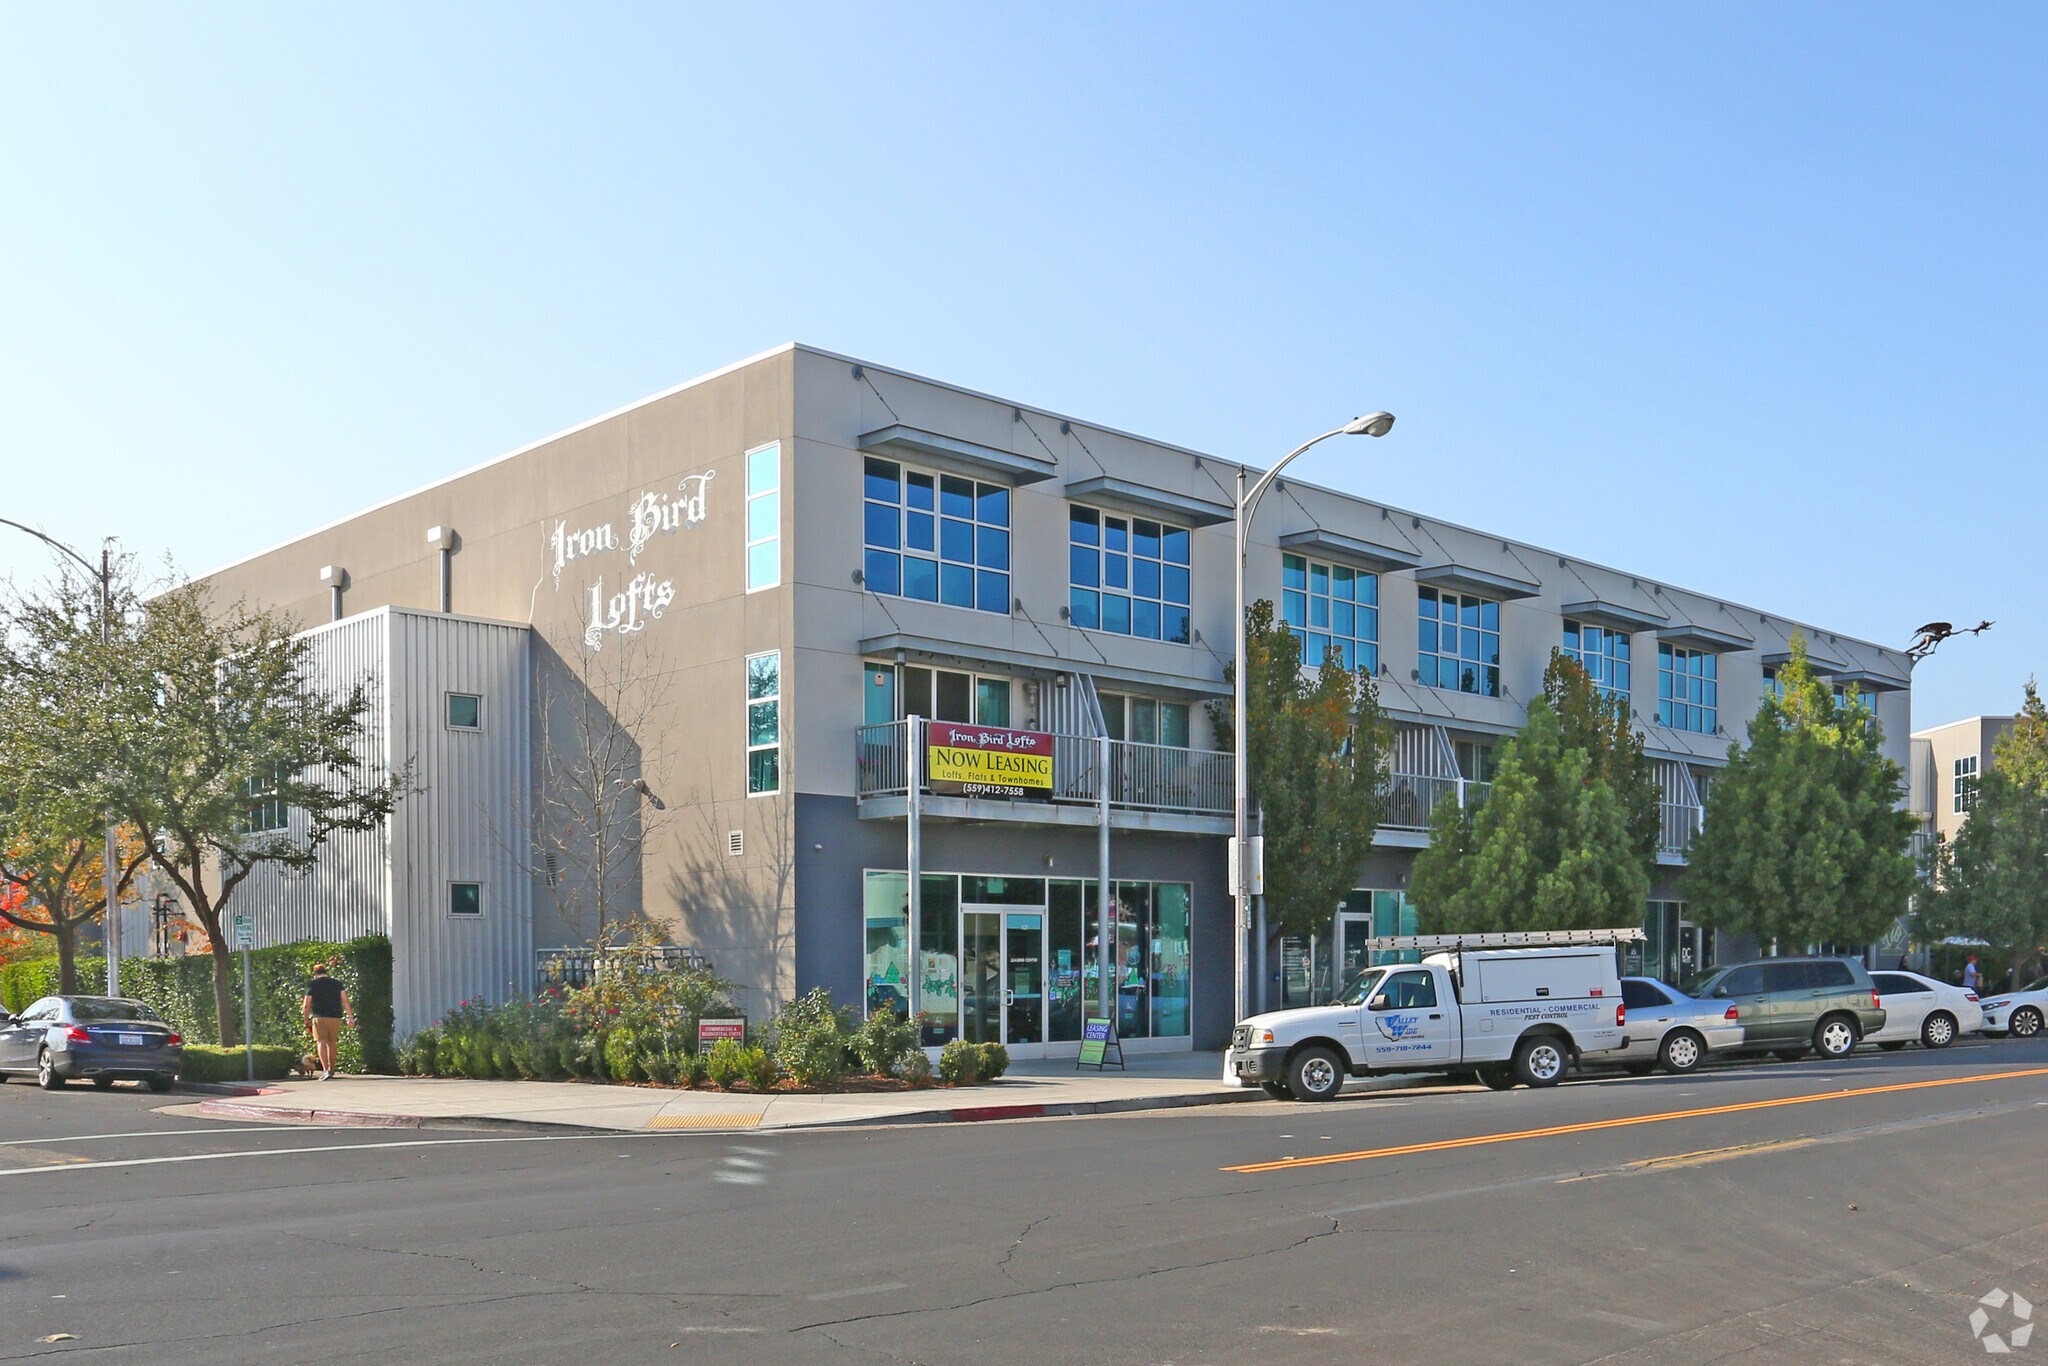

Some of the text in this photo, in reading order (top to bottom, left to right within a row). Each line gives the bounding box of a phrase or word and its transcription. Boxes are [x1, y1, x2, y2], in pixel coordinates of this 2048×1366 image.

[550, 469, 716, 592] Iron Bird
[585, 571, 677, 652] Lofts
[949, 728, 1037, 750] Iron Bird Lofts
[936, 748, 1048, 775] NOW LEASING
[968, 772, 987, 782] Flats
[990, 774, 995, 782] &
[998, 774, 1044, 786] Townhomes
[963, 783, 1024, 796] (559)412-7558
[1490, 1003, 1601, 1016] RESIDENTIAL COMMERCIAL
[1086, 1024, 1108, 1033] LEASING
[1086, 1032, 1106, 1040] CENTER
